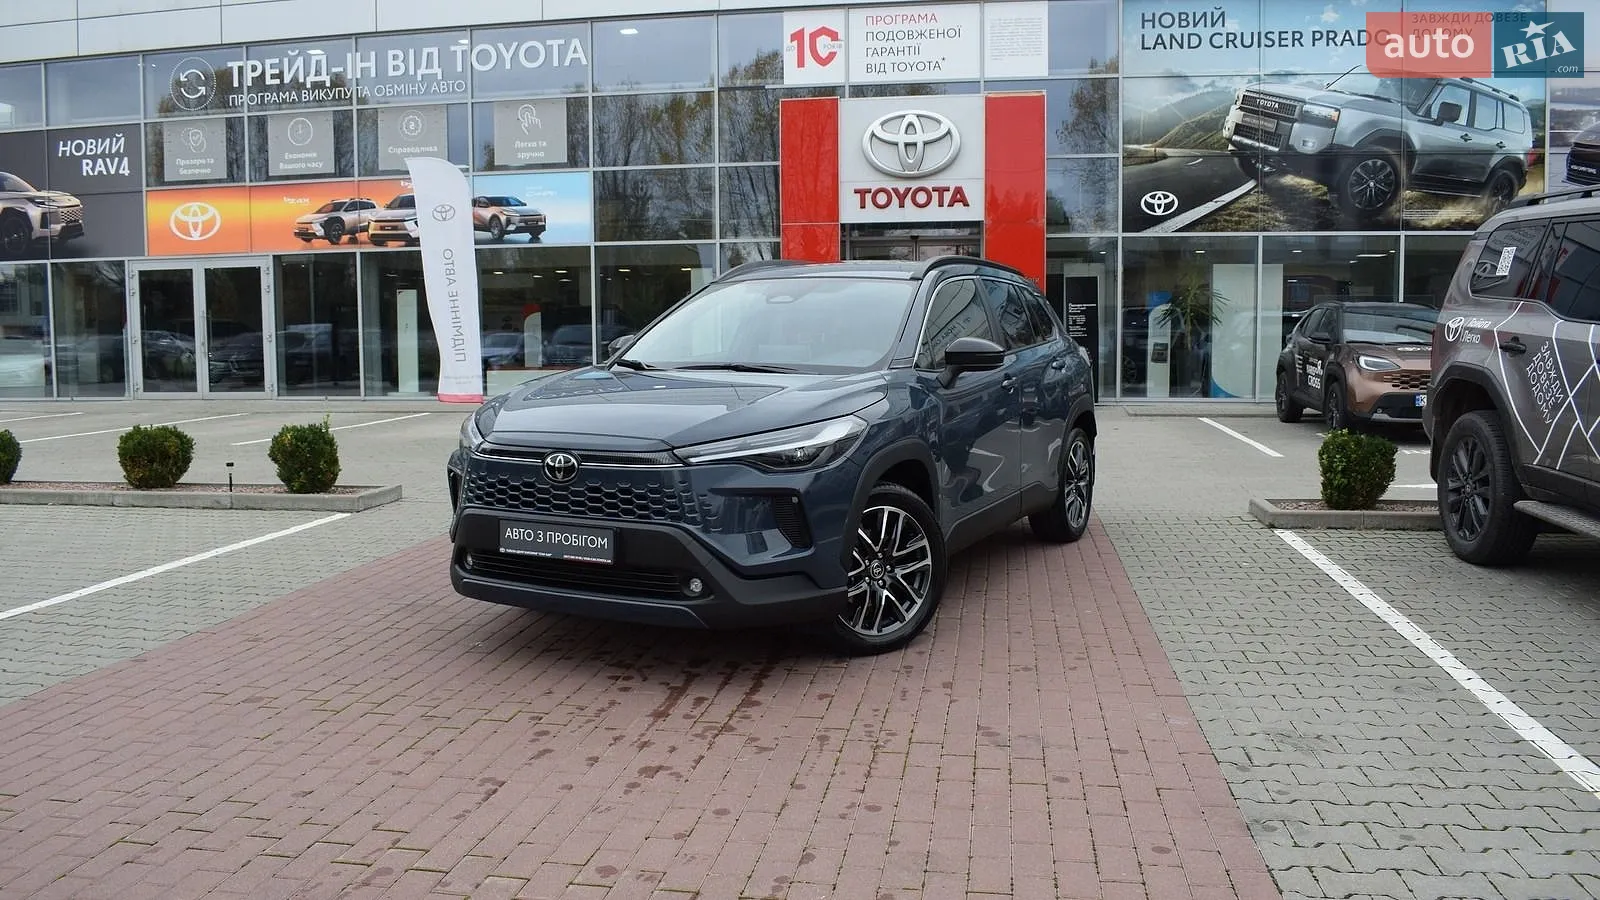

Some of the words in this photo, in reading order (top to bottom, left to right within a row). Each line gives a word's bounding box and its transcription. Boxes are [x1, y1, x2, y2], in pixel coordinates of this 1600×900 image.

[865, 13, 938, 26] ПРОГРАМА
[1141, 6, 1226, 29] НОВИЙ
[1411, 13, 1470, 24] ЗАВЖДИ
[1474, 12, 1527, 24] ДОВЕЗЕ
[865, 27, 962, 43] ПОДОВЖЕНОЇ
[1141, 32, 1203, 50] LAND
[1209, 31, 1304, 49] CRUISER
[1312, 30, 1392, 47] PRADO
[865, 43, 921, 58] ГАРАНТІЇ
[227, 49, 377, 89] ТРЕЙД-ІН
[387, 47, 443, 81] ВІД
[450, 38, 588, 73] TOYOTA
[866, 63, 887, 74] ВІД
[229, 90, 299, 107] ПРОГРАМА
[302, 86, 353, 102] ВИКУПУ
[356, 86, 371, 98] ТА
[374, 81, 428, 97] ОБМІНУ
[430, 80, 466, 94] АВТО
[1256, 99, 1279, 109] TOYOTA
[58, 133, 126, 157] НОВИЙ
[514, 140, 537, 149] Легко
[82, 156, 130, 177] RAV4
[854, 186, 970, 209] TOYOTA
[1462, 330, 1481, 344] Легко
[1532, 353, 1556, 409] ДОВЕЗЕ
[1541, 341, 1564, 404] ЗАВЖДИ
[1526, 363, 1553, 425] ДОДОМУ
[505, 527, 534, 542] АВТО
[546, 531, 608, 550] ПРОБІГОМ
